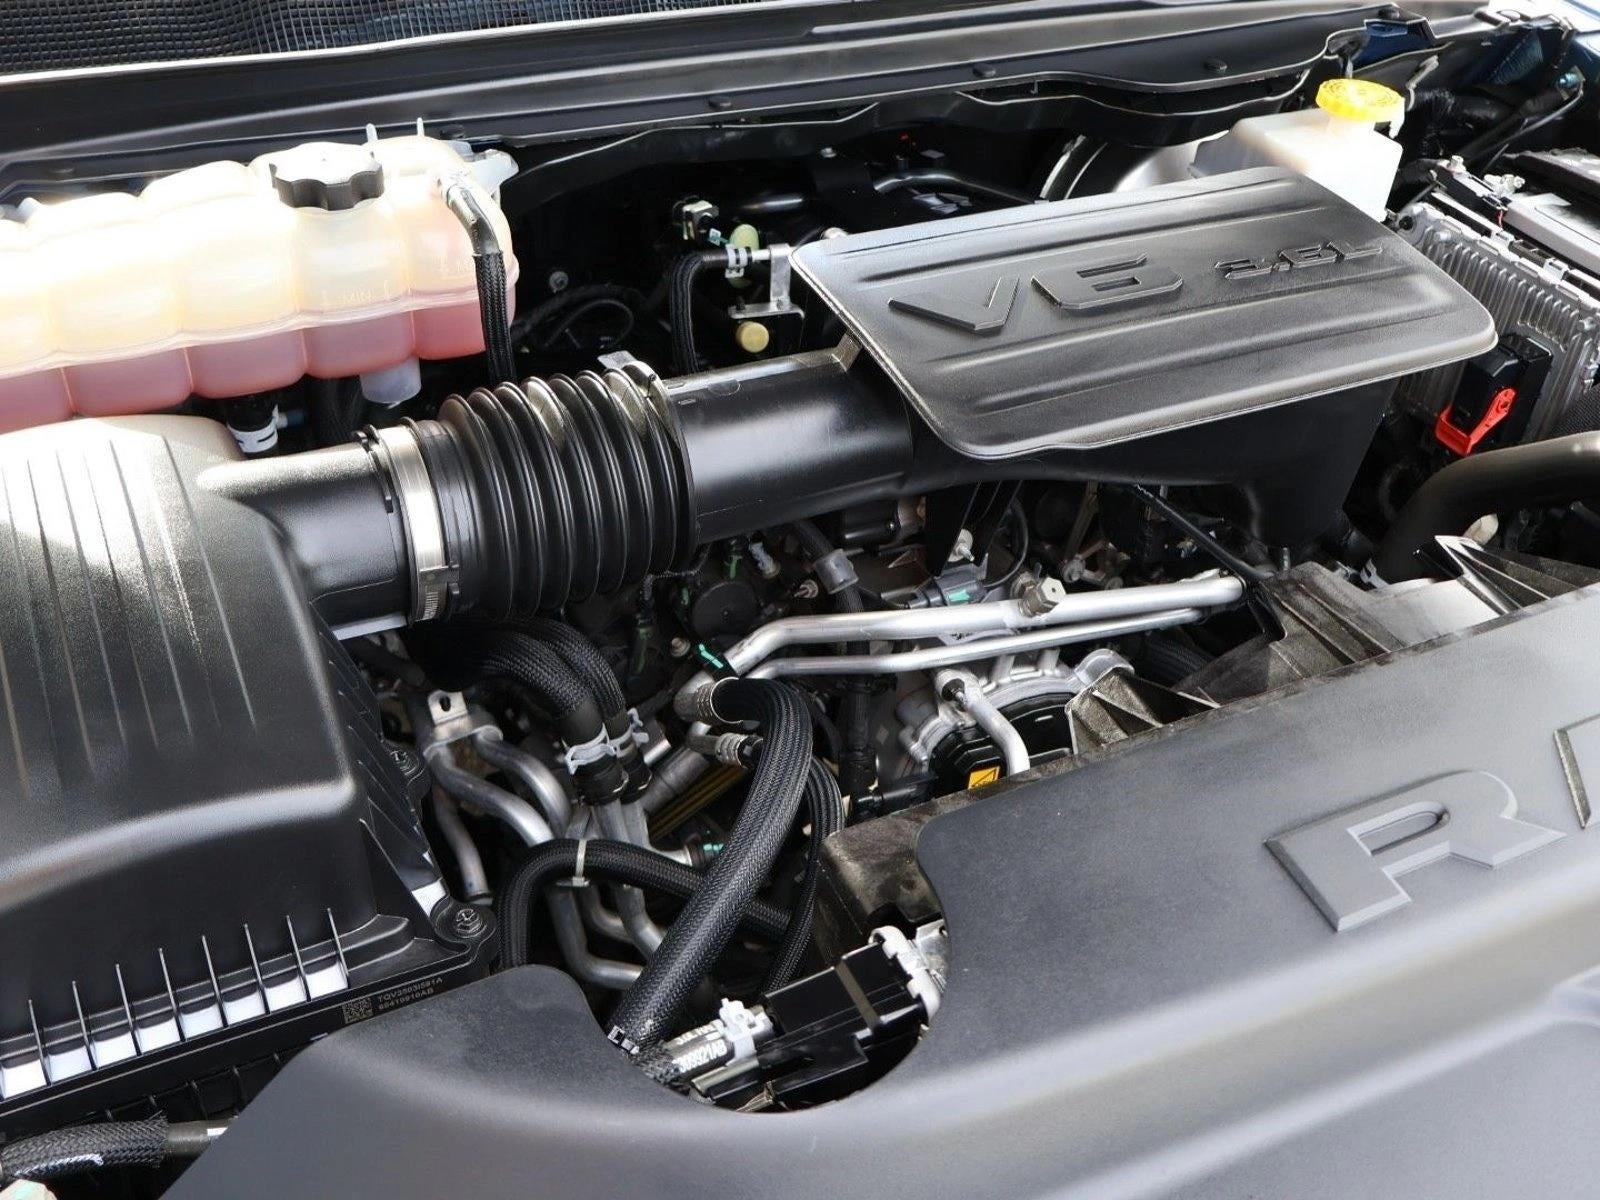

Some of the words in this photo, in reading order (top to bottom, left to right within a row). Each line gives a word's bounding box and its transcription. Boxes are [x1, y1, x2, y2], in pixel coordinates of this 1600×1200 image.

[887, 252, 1184, 333] V6
[1214, 241, 1384, 281] 3.6L
[1264, 714, 1600, 933] R
